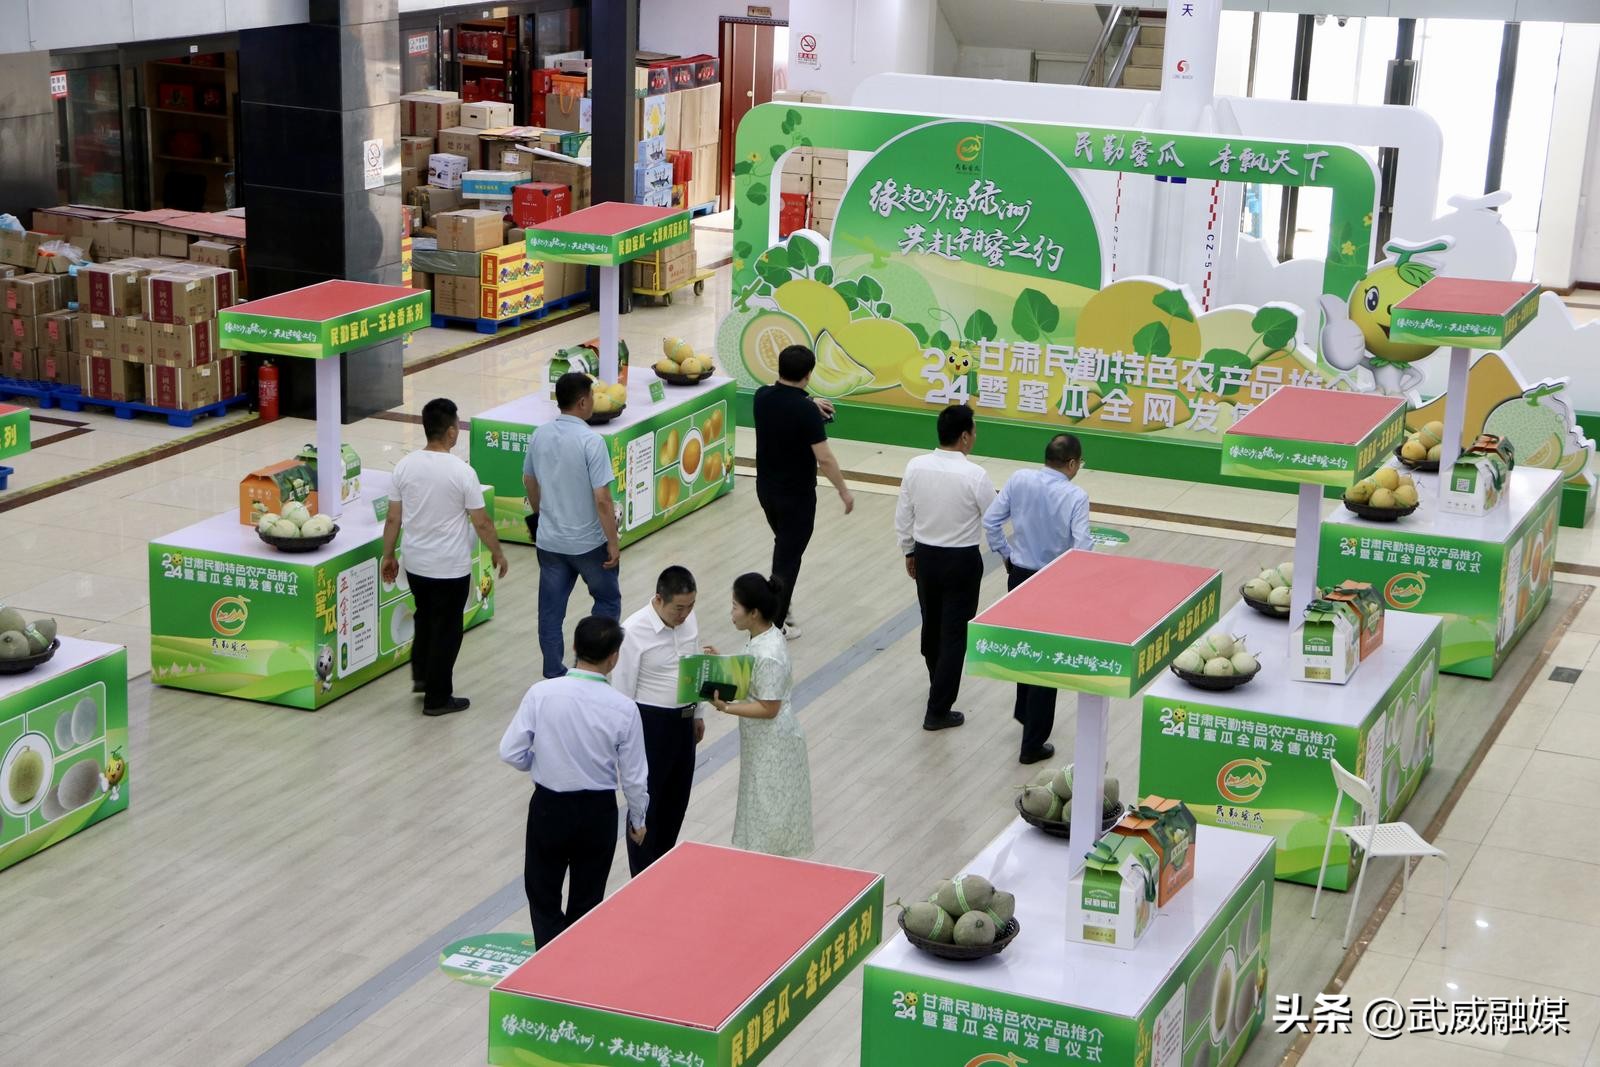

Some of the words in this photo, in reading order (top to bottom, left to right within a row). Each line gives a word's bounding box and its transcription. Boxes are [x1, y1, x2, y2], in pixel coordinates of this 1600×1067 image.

[1181, 3, 1193, 17] 天
[1074, 131, 1185, 168] 民勤蜜瓜
[1209, 143, 1329, 181] 香飘天下
[868, 177, 1033, 233] 缘起沙海绿洲
[898, 223, 1064, 272] 共赴甜蜜之约
[1204, 234, 1214, 268] CZ-5
[1360, 537, 1483, 563] 甘肃民勤特色农产品推介
[184, 557, 298, 583] 甘肃民勤特色农产品推介
[1187, 711, 1338, 746] 甘肃民勤特色农产品推介
[1187, 725, 1336, 760] 暨蜜瓜全网发售仪式
[922, 992, 1105, 1045] 甘肃民勤特色农产品推介
[921, 1010, 1103, 1063] 暨蜜瓜全网发售仪式
